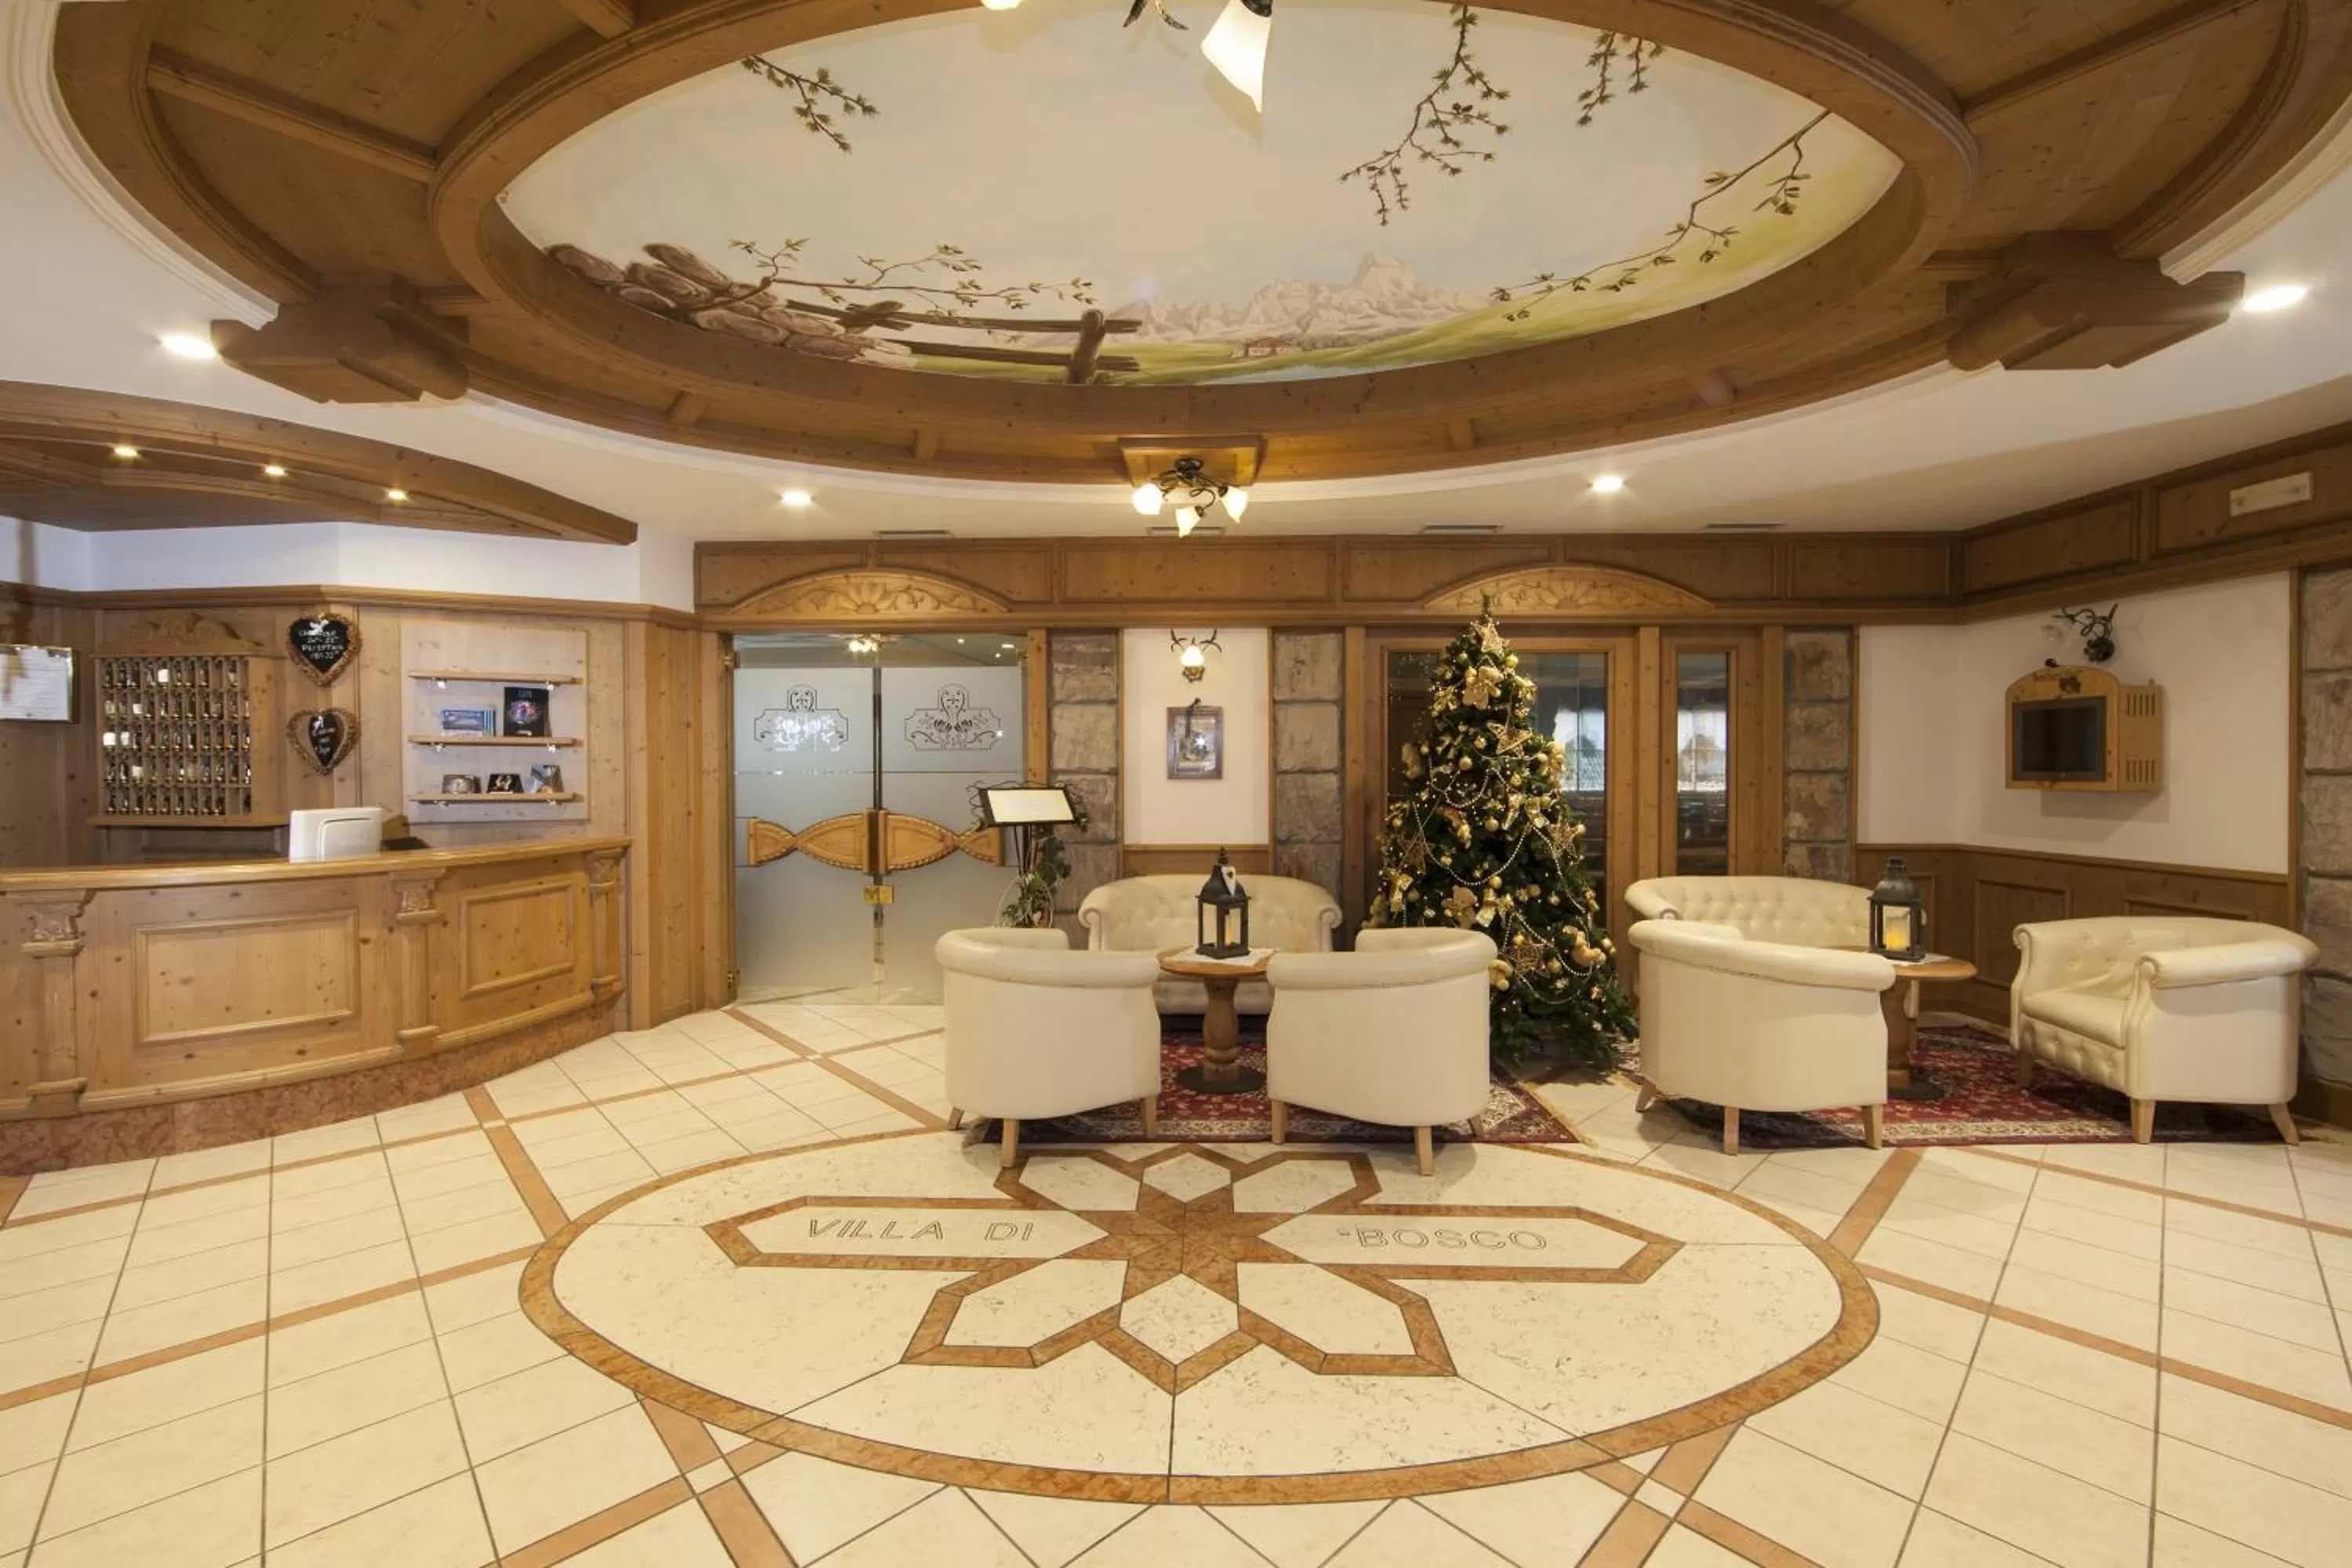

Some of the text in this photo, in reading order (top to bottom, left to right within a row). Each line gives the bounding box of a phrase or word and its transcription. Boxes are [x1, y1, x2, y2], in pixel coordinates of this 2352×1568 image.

[808, 1218, 1548, 1251] VILLA DI BOSCO
